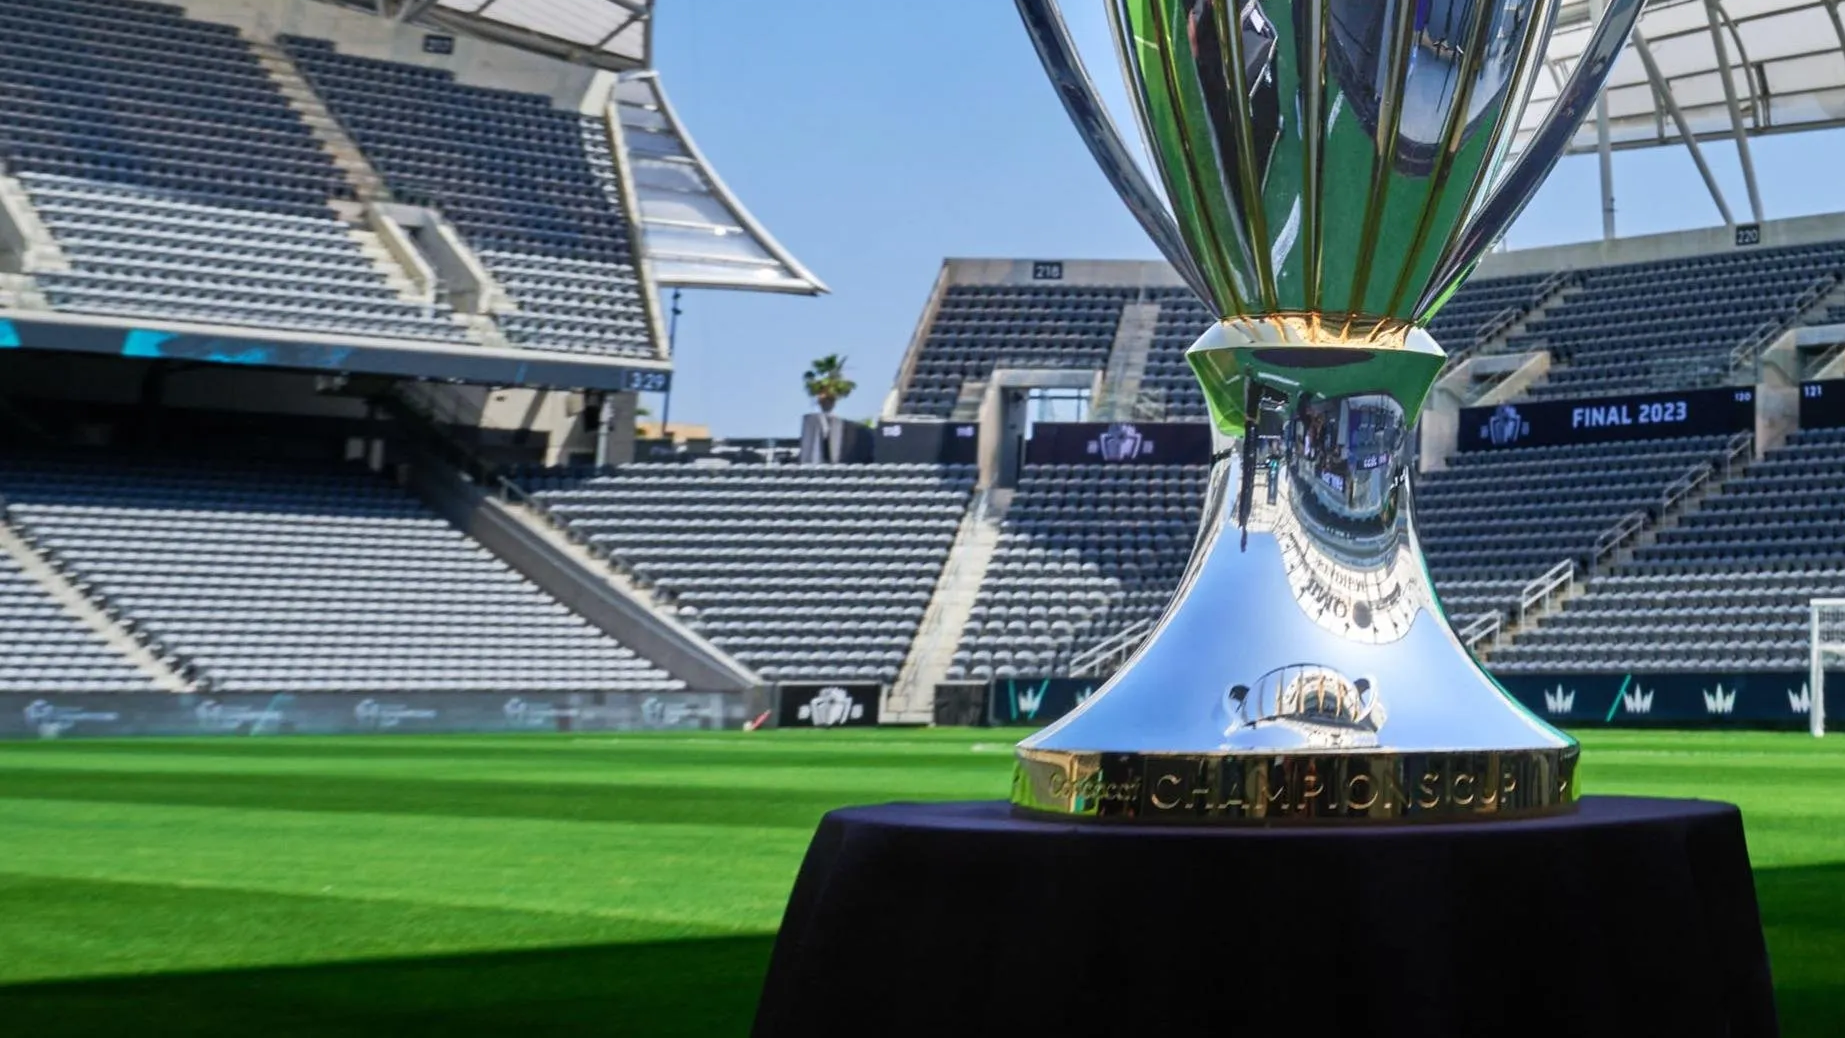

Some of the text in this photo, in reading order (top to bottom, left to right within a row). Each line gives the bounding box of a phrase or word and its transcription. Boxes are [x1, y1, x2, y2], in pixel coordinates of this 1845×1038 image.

[1737, 229, 1758, 243] 220
[1036, 264, 1060, 278] 218
[1804, 385, 1822, 397] 121
[1572, 400, 1687, 430] FINAL 2023
[1151, 773, 1441, 810] CHAMPIONS
[1453, 773, 1517, 806] CUP
